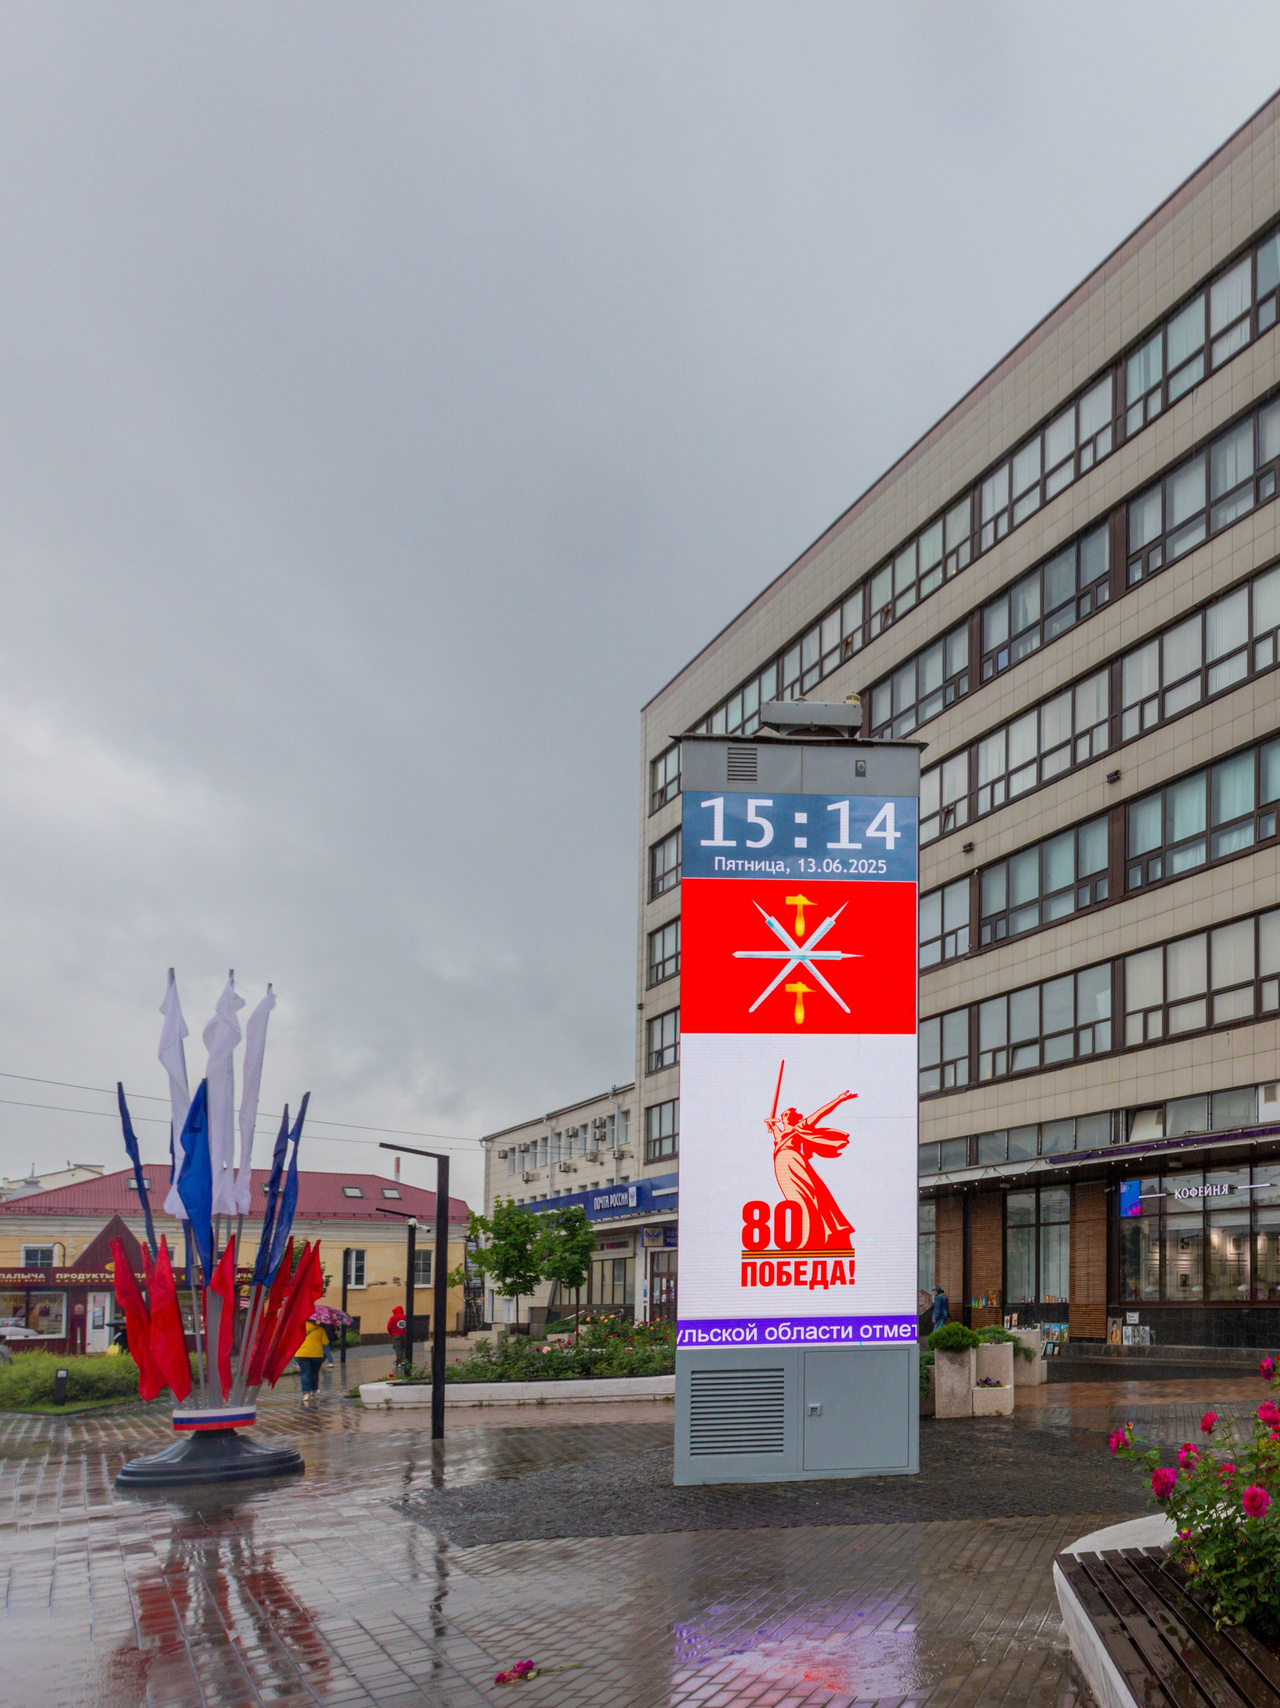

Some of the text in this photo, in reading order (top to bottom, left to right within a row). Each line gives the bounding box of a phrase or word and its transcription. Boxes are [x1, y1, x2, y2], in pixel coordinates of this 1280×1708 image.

[700, 797, 902, 850] 15:14
[714, 857, 888, 874] Пятница, 13.06.2025
[593, 1191, 629, 1210] ПОЧТА РОССИИ
[1174, 1183, 1229, 1199] КОФЕЙНЯ
[741, 1200, 803, 1250] 80
[56, 1272, 115, 1280] ПРОДУКТЫ
[741, 1260, 855, 1290] ПОБЕДА!
[765, 1322, 853, 1341] области
